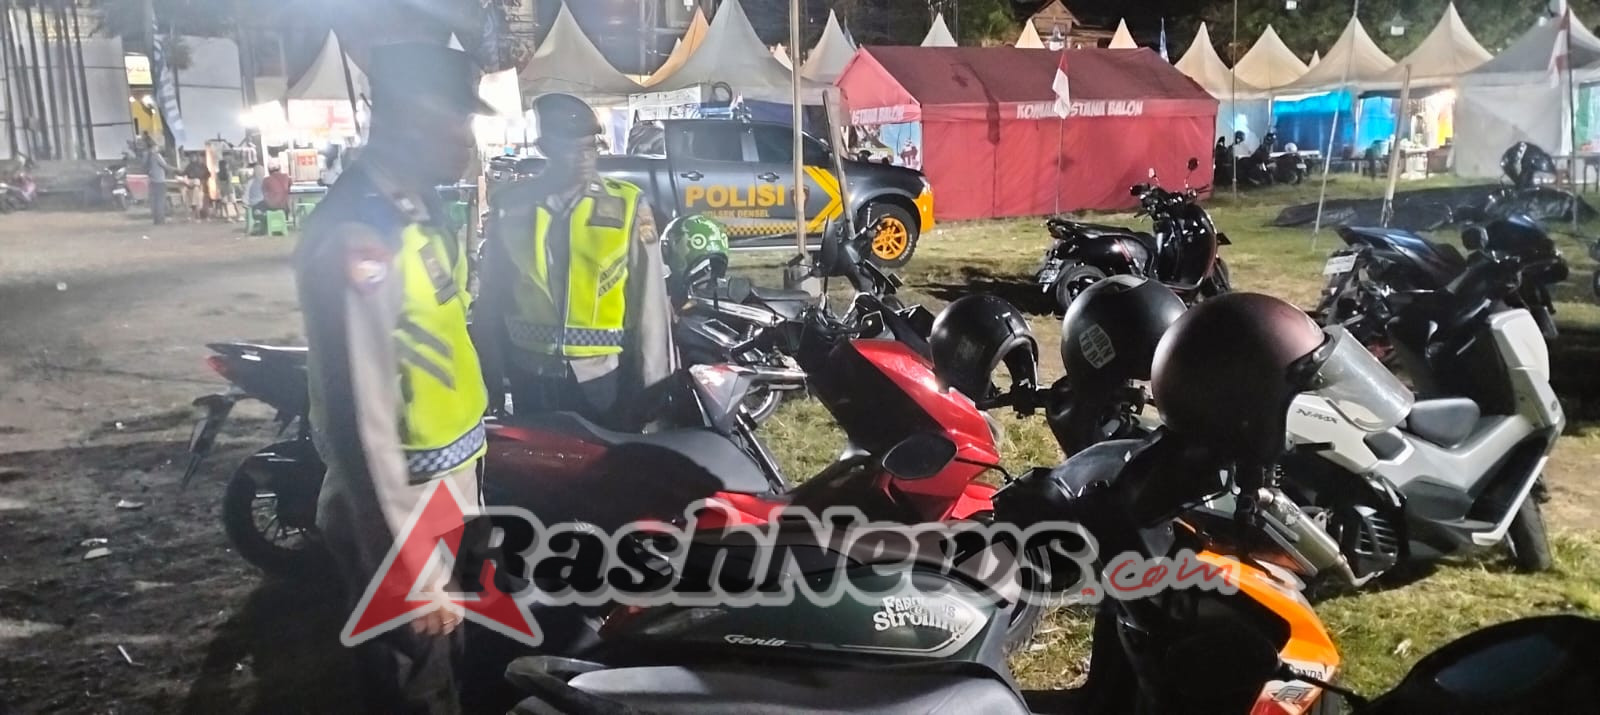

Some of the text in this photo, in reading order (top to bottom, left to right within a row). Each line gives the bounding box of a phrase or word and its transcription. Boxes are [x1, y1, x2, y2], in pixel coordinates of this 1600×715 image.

[1070, 101, 1105, 117] STANA
[1107, 101, 1143, 116] BALON
[685, 184, 785, 208] POLISI
[723, 634, 787, 647] Genio
